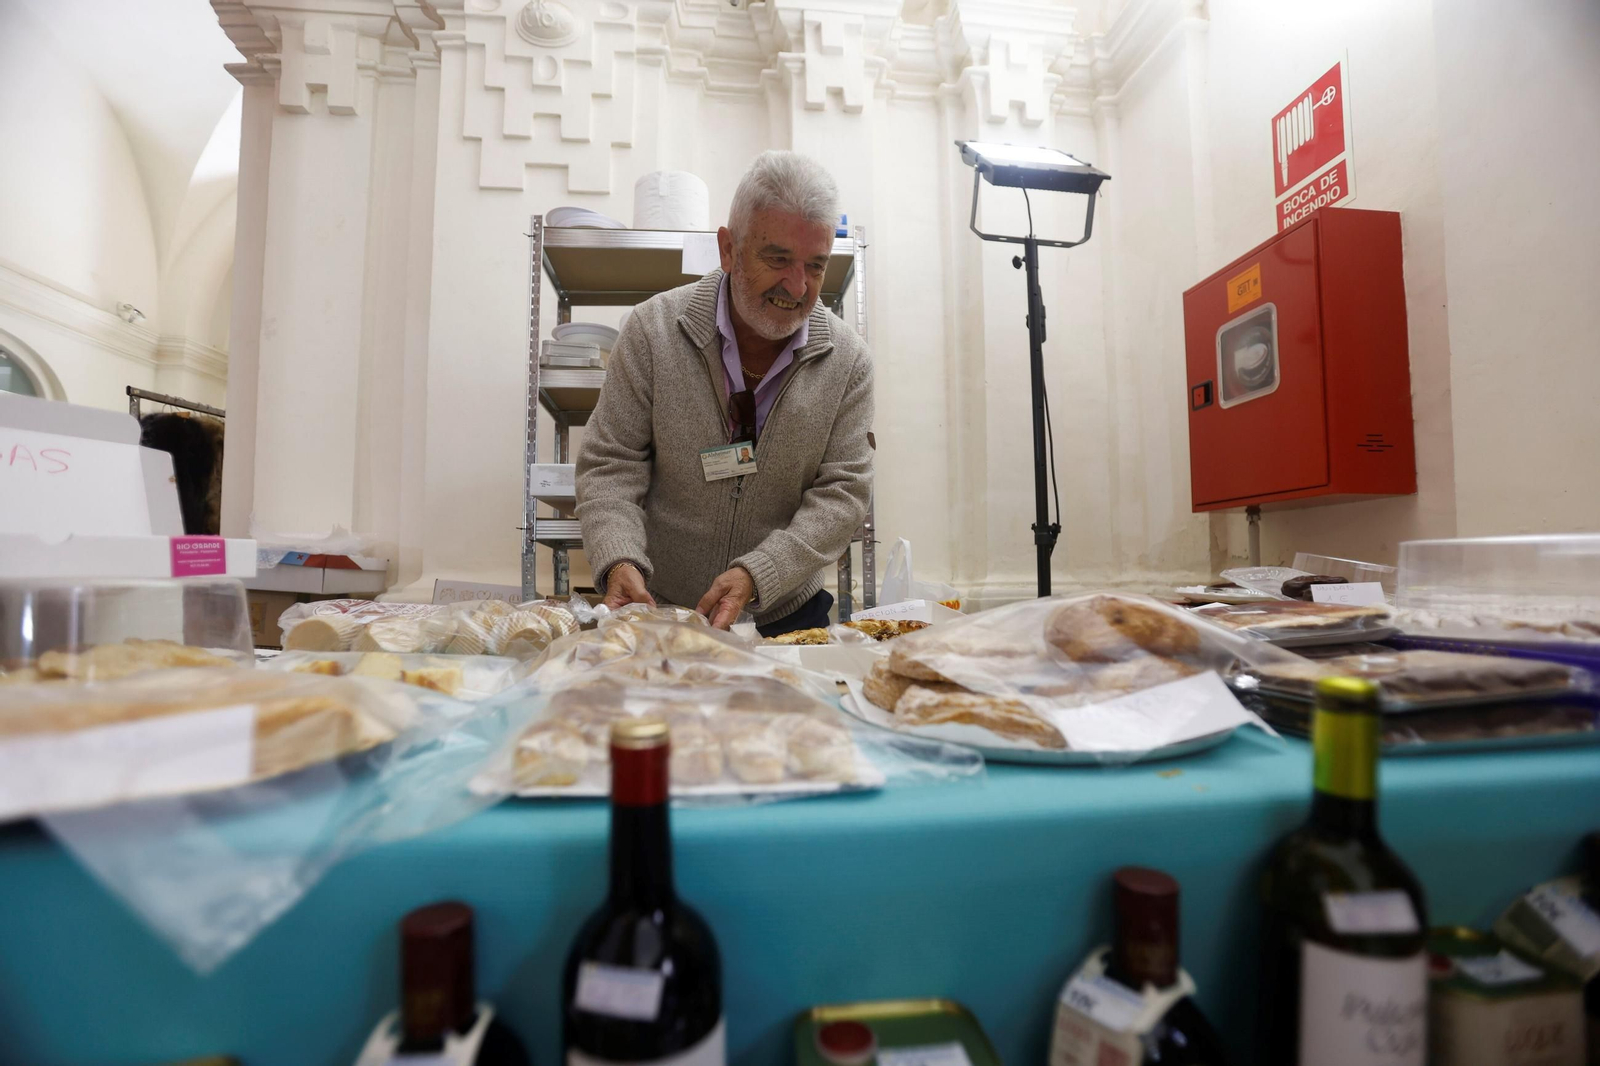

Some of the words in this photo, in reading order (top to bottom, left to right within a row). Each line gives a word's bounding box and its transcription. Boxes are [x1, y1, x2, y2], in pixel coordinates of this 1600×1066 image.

[1283, 185, 1317, 215] BOCA
[1320, 169, 1338, 191] DE
[1283, 185, 1341, 230] INCENDIO
[0, 443, 72, 474] AS
[191, 542, 221, 550] GRANDE
